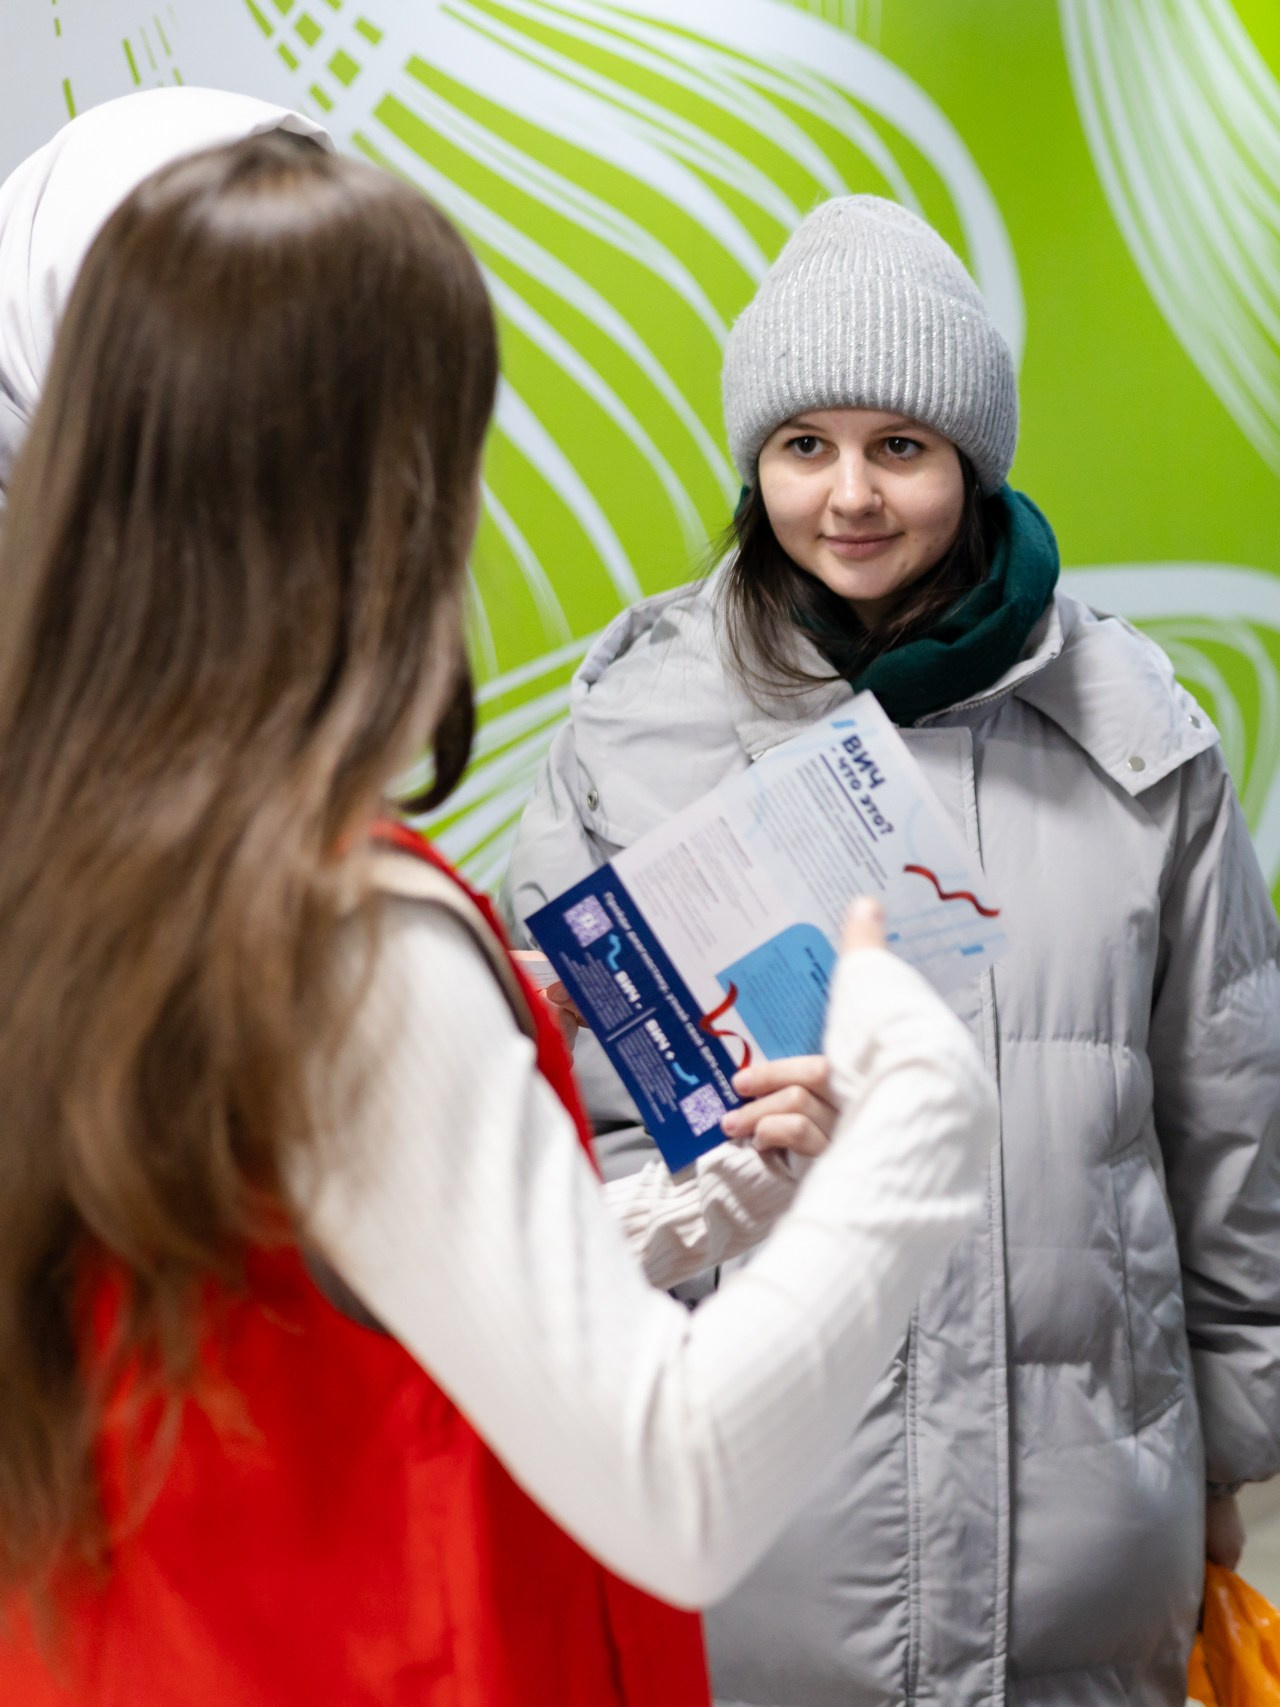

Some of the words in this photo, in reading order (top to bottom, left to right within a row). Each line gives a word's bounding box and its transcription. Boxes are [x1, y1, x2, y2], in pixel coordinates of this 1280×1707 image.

[841, 733, 886, 789] ВИЧ
[614, 970, 641, 1003] ВИЧ
[645, 1018, 670, 1051] ВИЧ
